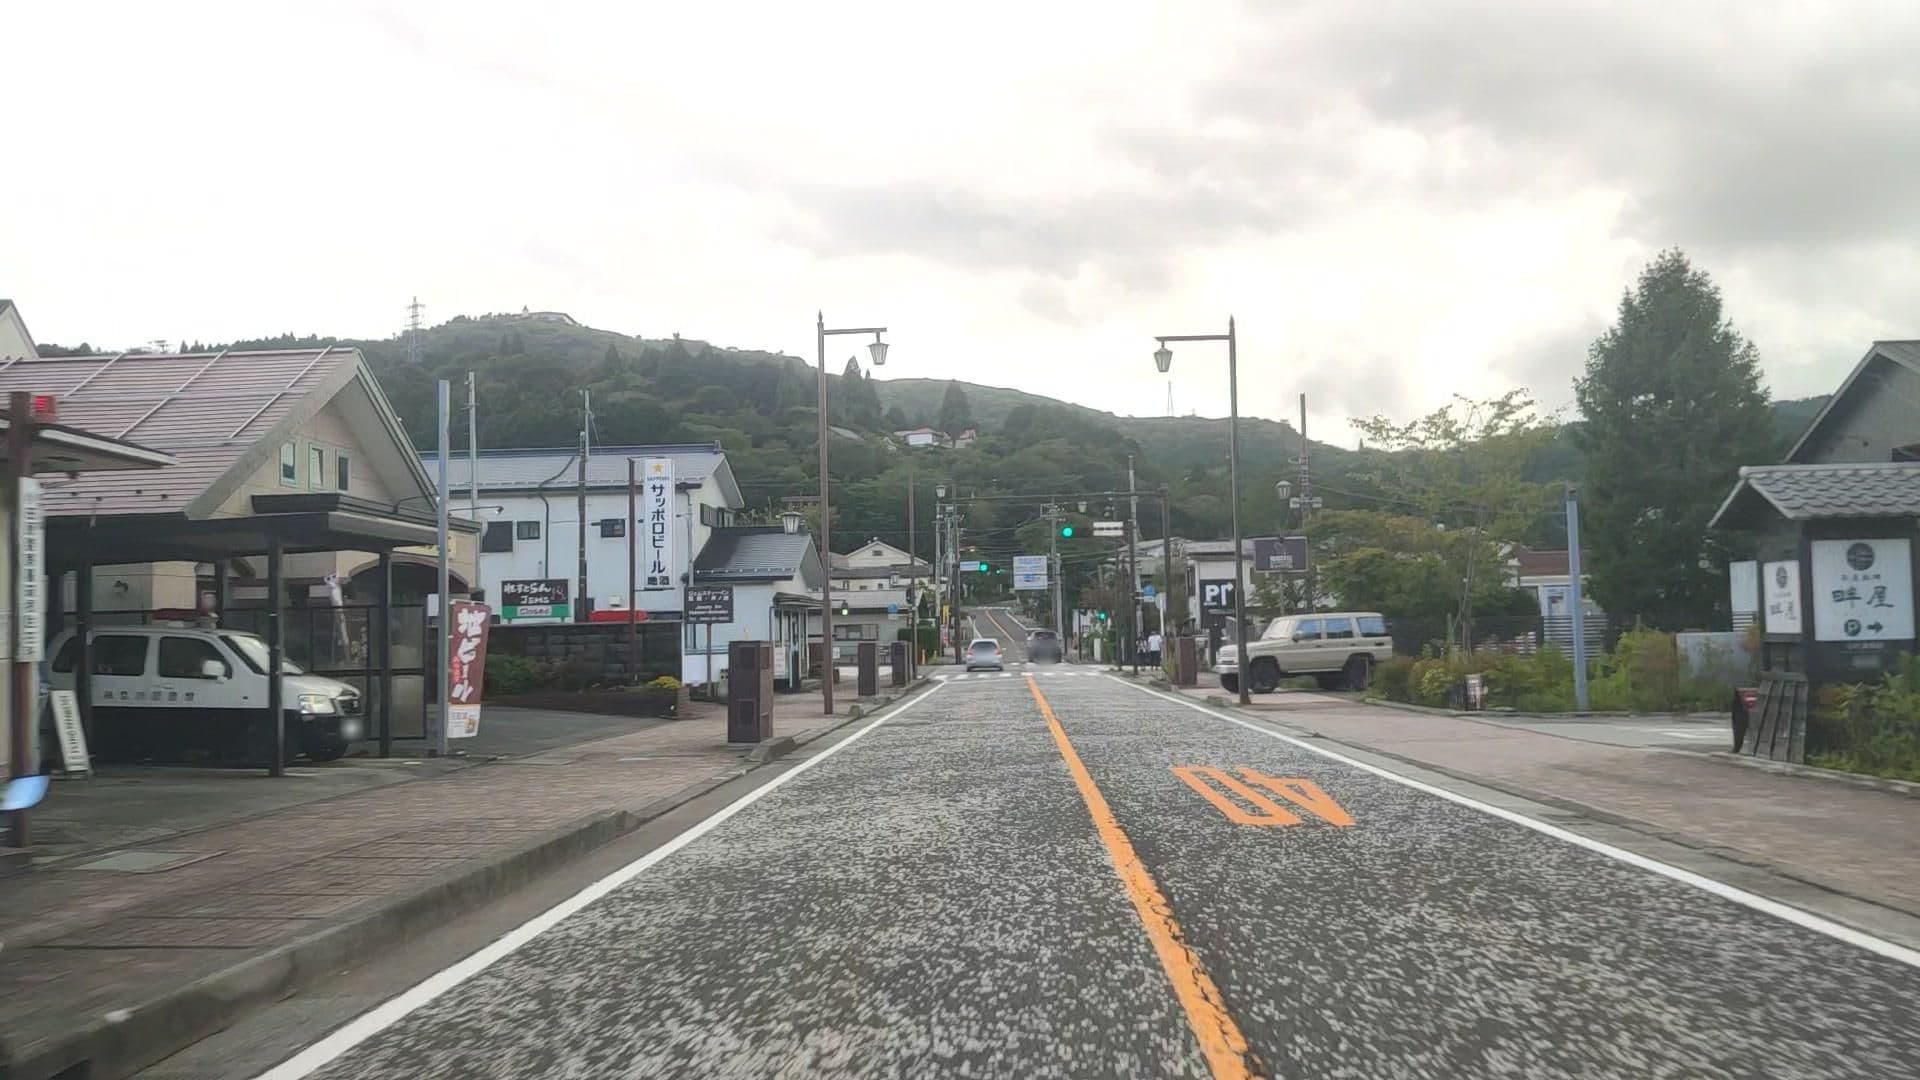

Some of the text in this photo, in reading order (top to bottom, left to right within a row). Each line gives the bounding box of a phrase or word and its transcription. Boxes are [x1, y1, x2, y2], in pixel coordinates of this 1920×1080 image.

[651, 484, 666, 573] サッポロビール
[1168, 764, 1357, 827] 40
